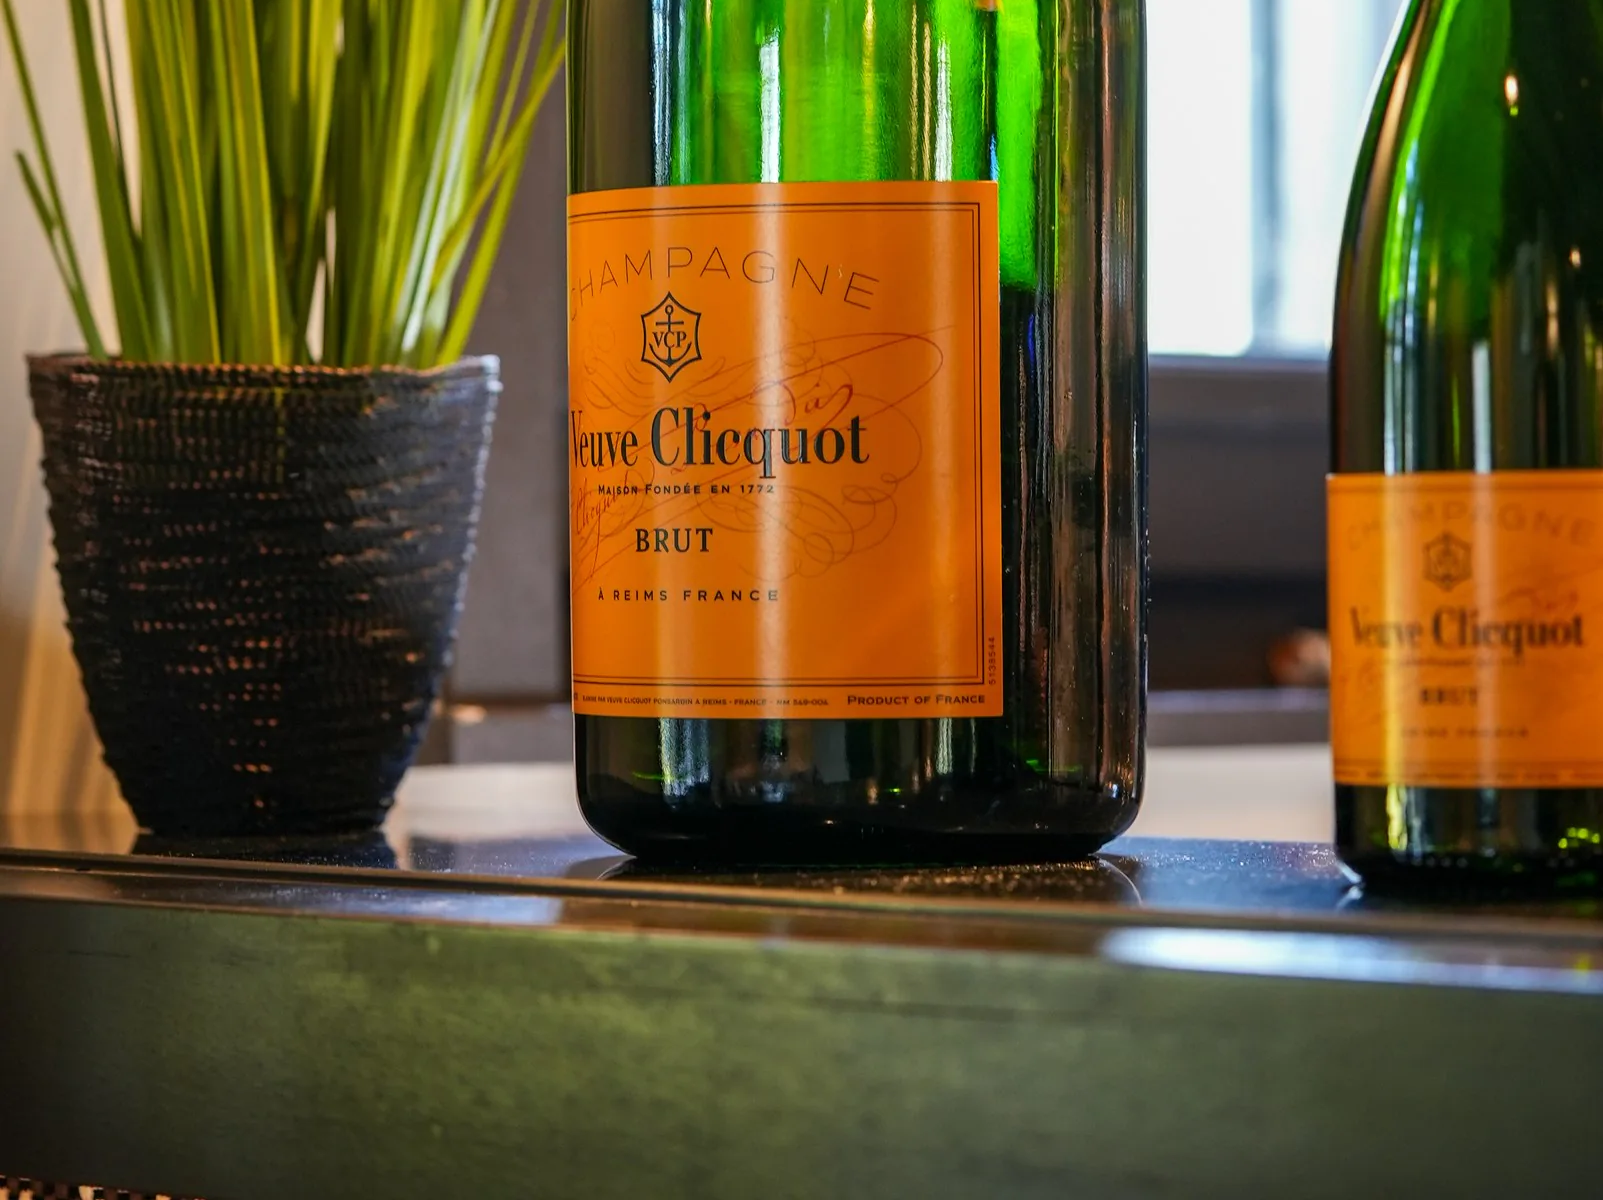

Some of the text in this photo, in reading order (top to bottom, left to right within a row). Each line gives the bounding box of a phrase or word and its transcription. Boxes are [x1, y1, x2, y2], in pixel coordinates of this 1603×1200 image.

[570, 246, 880, 322] CHAMPAGNE
[652, 331, 687, 348] VCP
[570, 406, 870, 480] Veuve Clicquot
[645, 482, 701, 495] FONDÉE
[711, 485, 730, 495] EN
[740, 484, 775, 495] 1772
[635, 527, 714, 553] BRUT
[613, 589, 668, 602] REIMS
[683, 589, 779, 602] FRANCE
[1431, 605, 1585, 657] Clicquot
[847, 693, 985, 706] PRODUCT OF FRANCE
